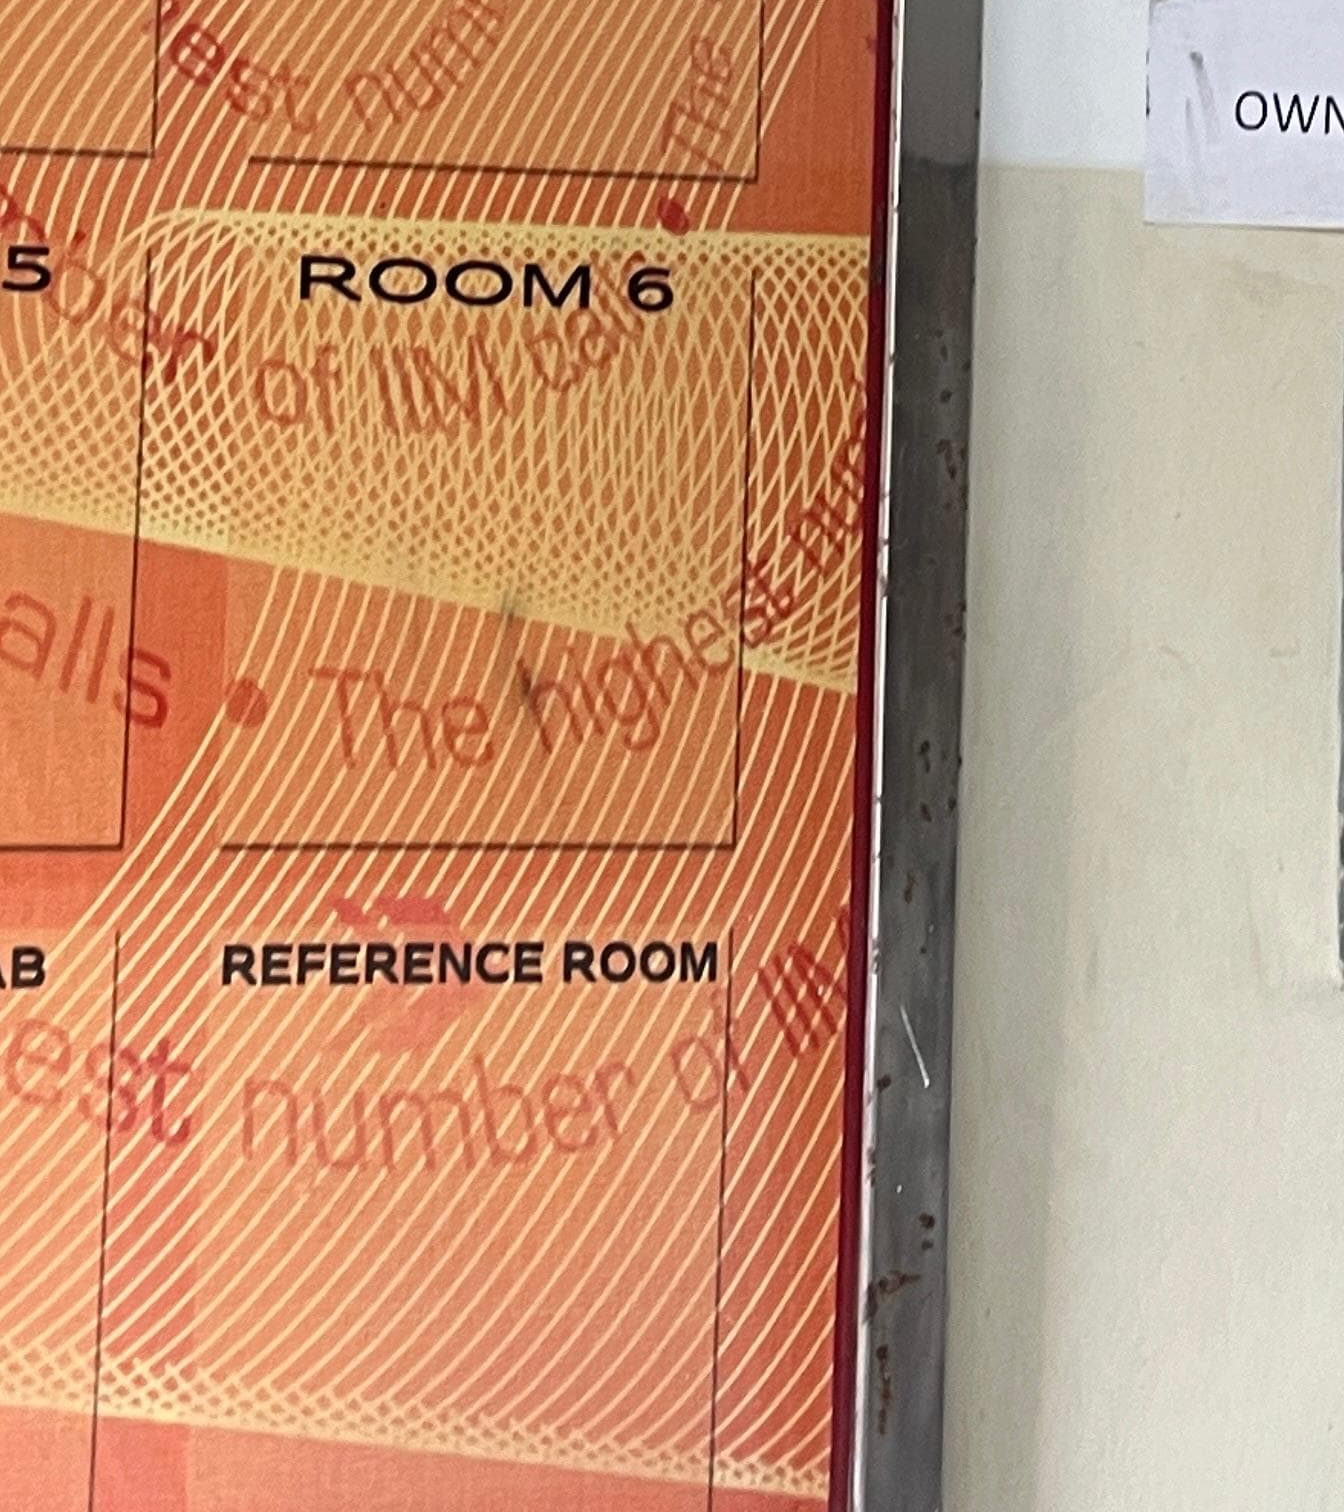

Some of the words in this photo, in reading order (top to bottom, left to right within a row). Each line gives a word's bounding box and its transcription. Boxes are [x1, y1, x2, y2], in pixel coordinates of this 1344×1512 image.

[0, 245, 52, 292] 5
[298, 254, 592, 310] ROOM
[626, 266, 676, 313] 6
[308, 664, 494, 773] The
[222, 941, 544, 987] REFERENCE
[561, 941, 719, 985] ROOM
[238, 1054, 636, 1172] number
